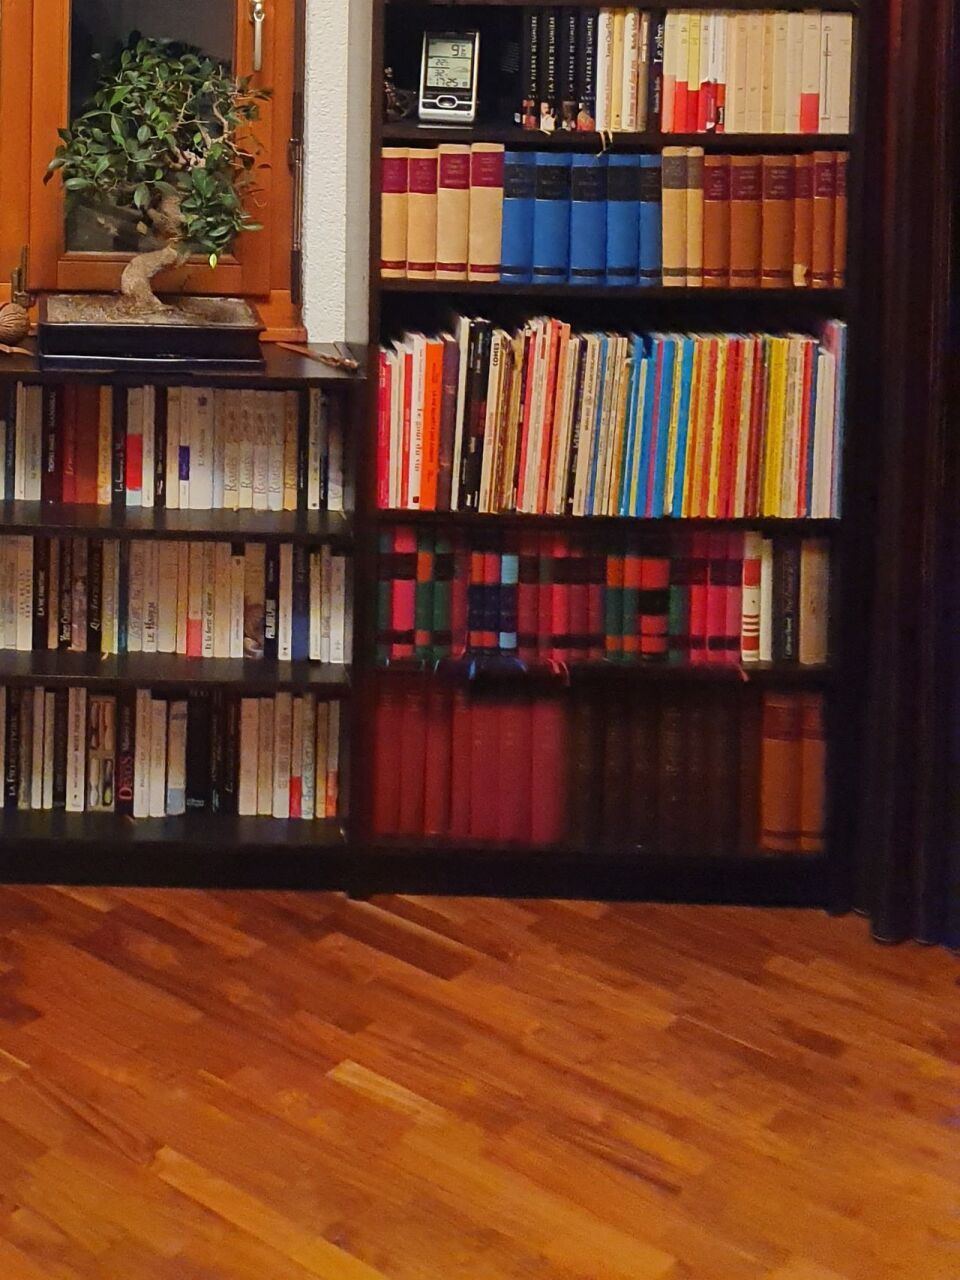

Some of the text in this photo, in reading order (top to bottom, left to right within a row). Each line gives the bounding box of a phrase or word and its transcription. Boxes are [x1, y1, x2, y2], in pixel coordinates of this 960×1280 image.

[653, 24, 663, 64] Le zèbre
[531, 83, 537, 92] LA
[548, 84, 554, 93] LA
[569, 84, 575, 93] LA
[586, 85, 592, 94] LA
